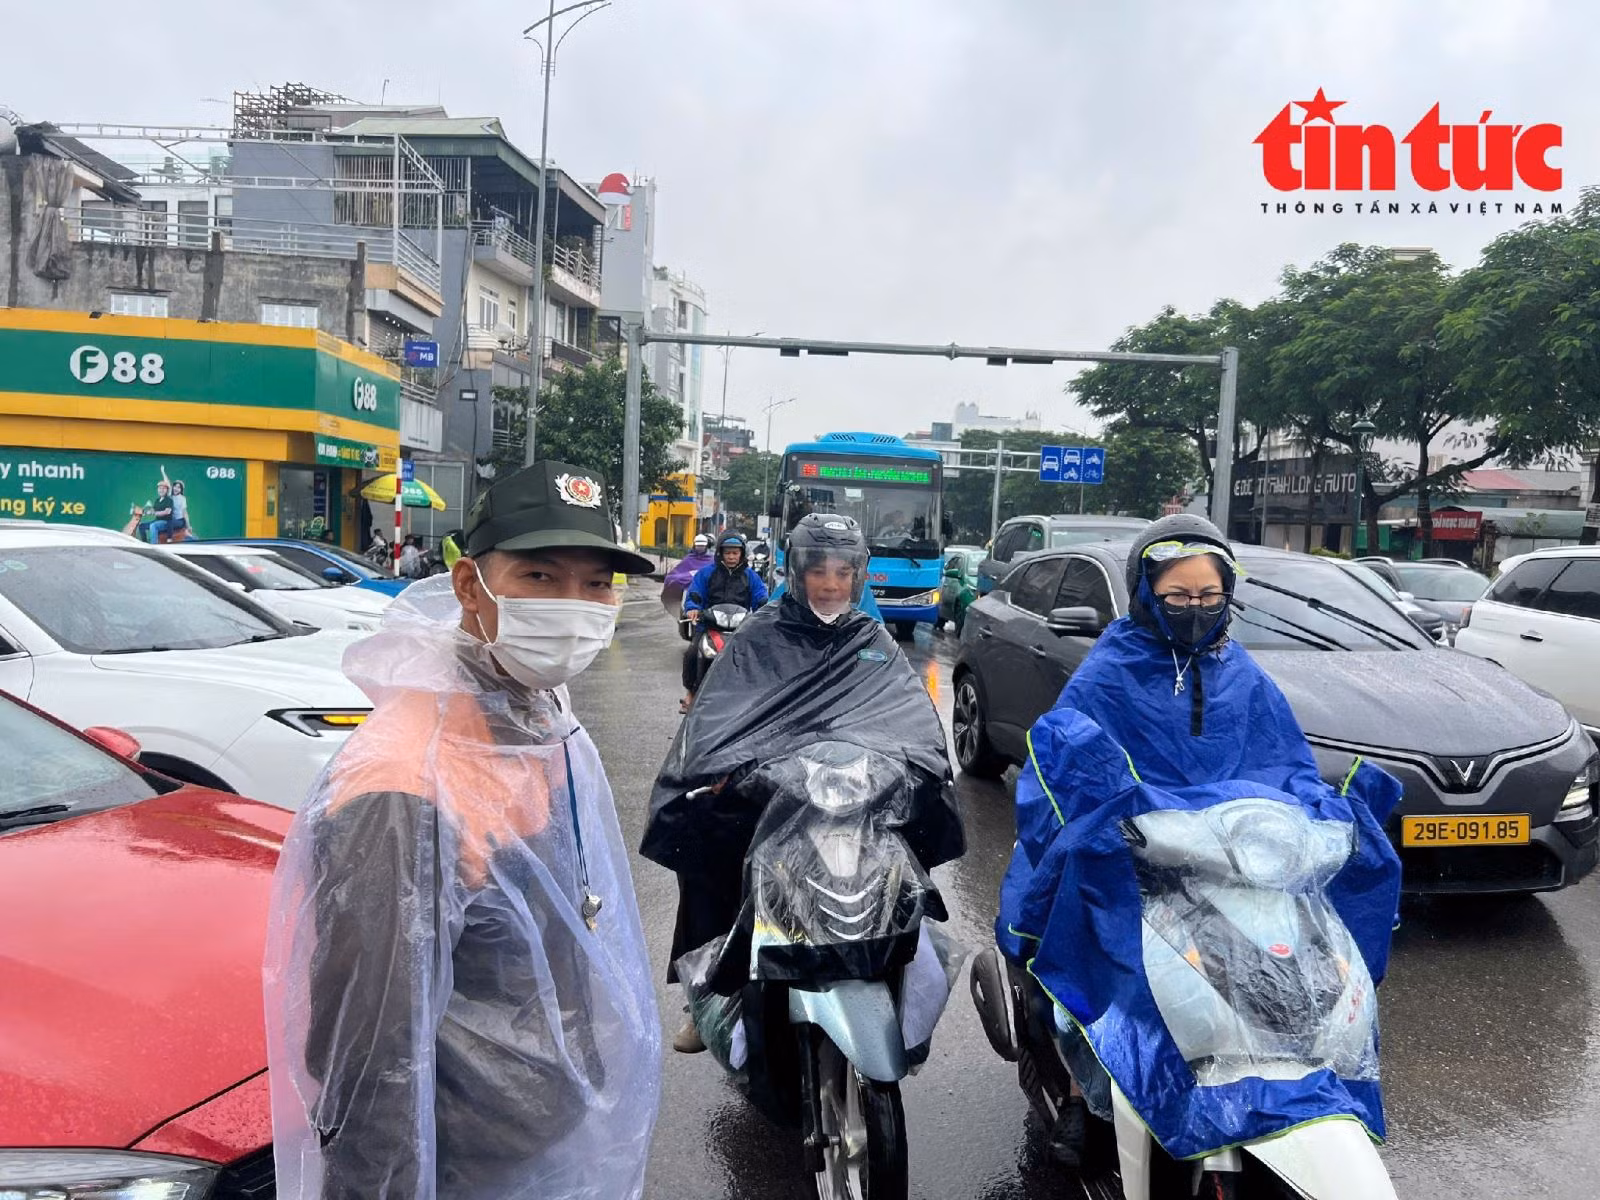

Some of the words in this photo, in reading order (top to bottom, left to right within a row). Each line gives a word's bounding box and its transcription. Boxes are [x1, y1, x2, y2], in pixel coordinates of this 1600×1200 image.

[70, 345, 164, 384] F88
[419, 352, 434, 361] MB
[354, 377, 377, 411] F88
[18, 460, 84, 480] nhanh
[206, 466, 235, 479] F88
[1324, 473, 1357, 493] AUTO
[32, 496, 55, 516] ký
[61, 502, 86, 514] xe
[1414, 821, 1519, 840] 29E-091.85
